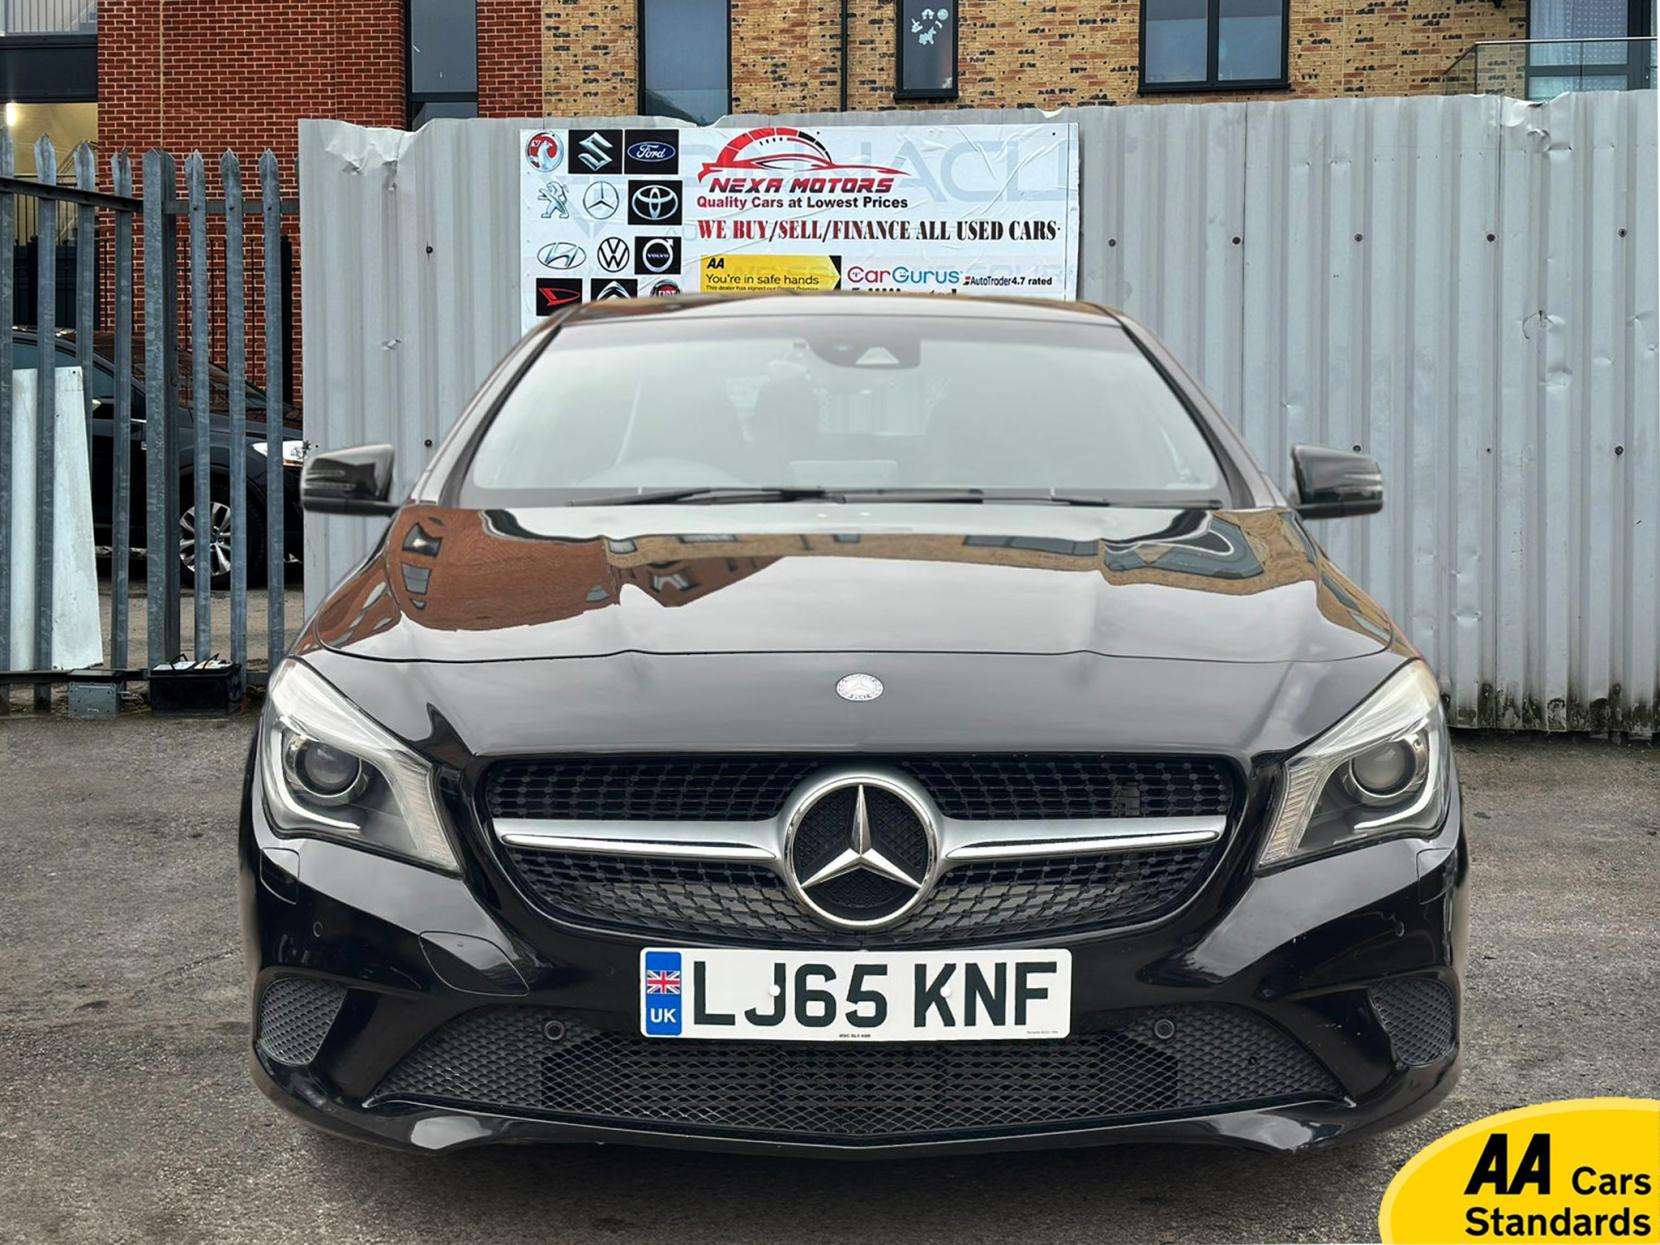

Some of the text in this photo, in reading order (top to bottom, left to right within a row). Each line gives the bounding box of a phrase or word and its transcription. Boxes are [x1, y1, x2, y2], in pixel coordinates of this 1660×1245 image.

[636, 144, 666, 158] Ford
[708, 177, 895, 194] NEXA MOTORS
[697, 196, 908, 210] Quality Cars at Lowest Prices
[697, 219, 726, 239] WE
[916, 220, 951, 240] ALL
[956, 220, 1004, 241] USED
[1008, 220, 1057, 240] CARS
[706, 258, 725, 269] AA
[706, 273, 819, 285] You're in safe hands
[847, 266, 960, 284] CarGurus
[1028, 276, 1053, 286] rated
[693, 961, 1058, 1028] LJ65 KNF
[650, 1007, 677, 1024] UK
